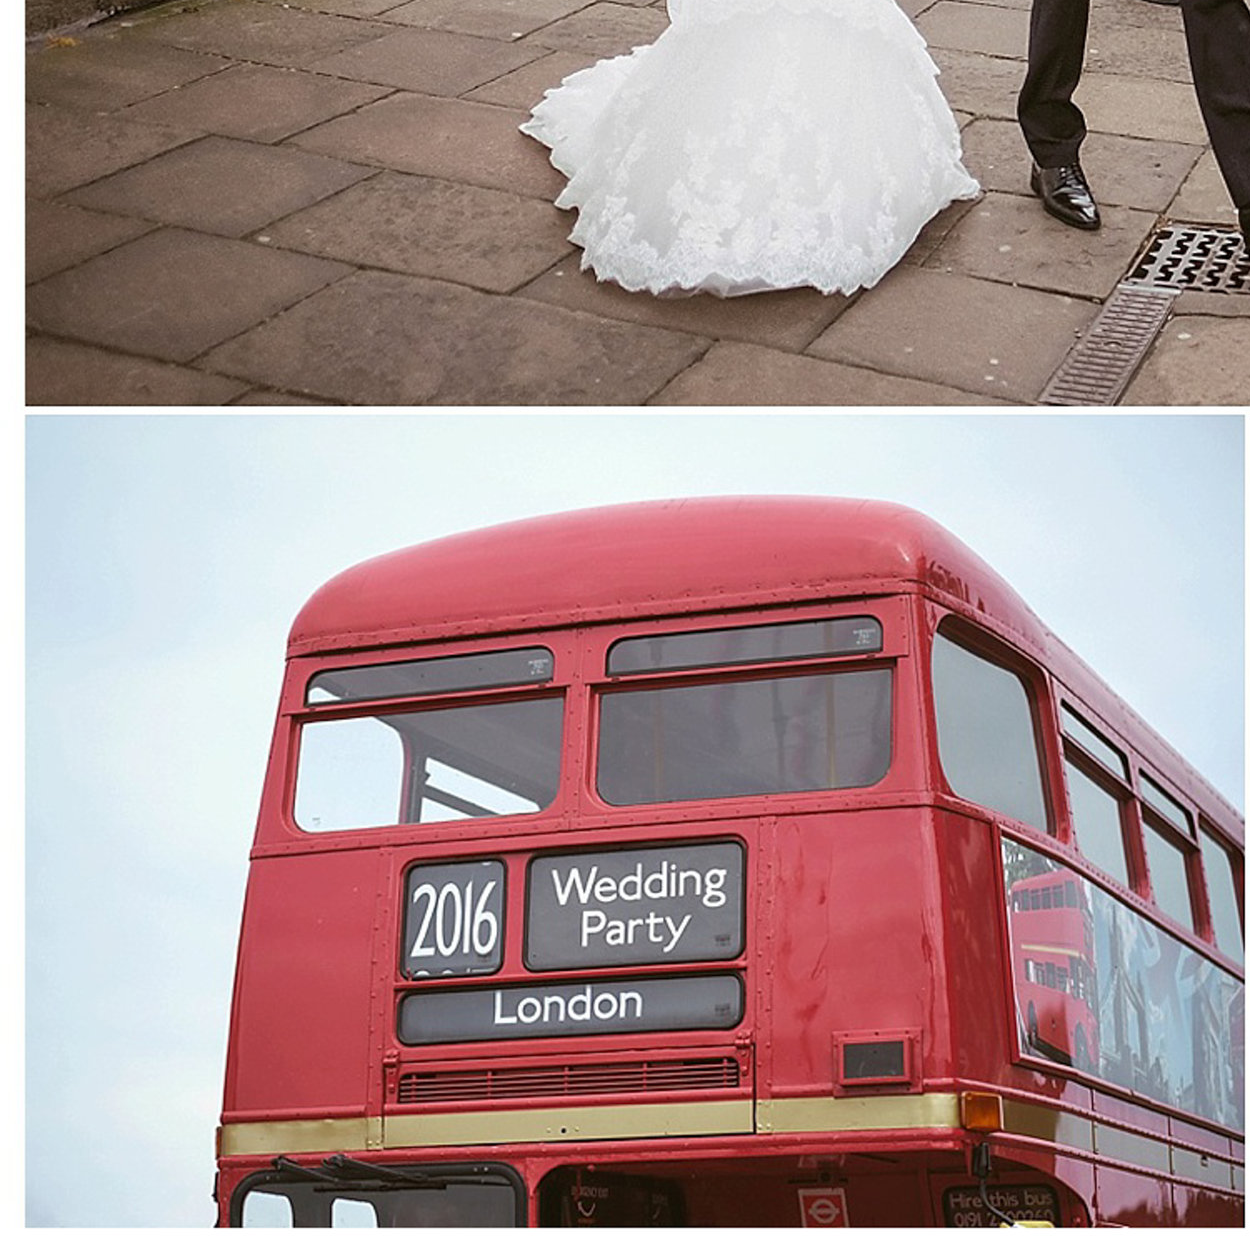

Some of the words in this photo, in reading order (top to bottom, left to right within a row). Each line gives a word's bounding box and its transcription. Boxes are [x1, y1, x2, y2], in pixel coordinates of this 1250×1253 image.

[552, 860, 728, 908] Wedding
[410, 880, 499, 958] 2016
[580, 910, 692, 954] Party
[494, 984, 642, 1025] London
[949, 1192, 983, 1209] Hire
[988, 1190, 1020, 1207] this
[1024, 1189, 1053, 1206] bus
